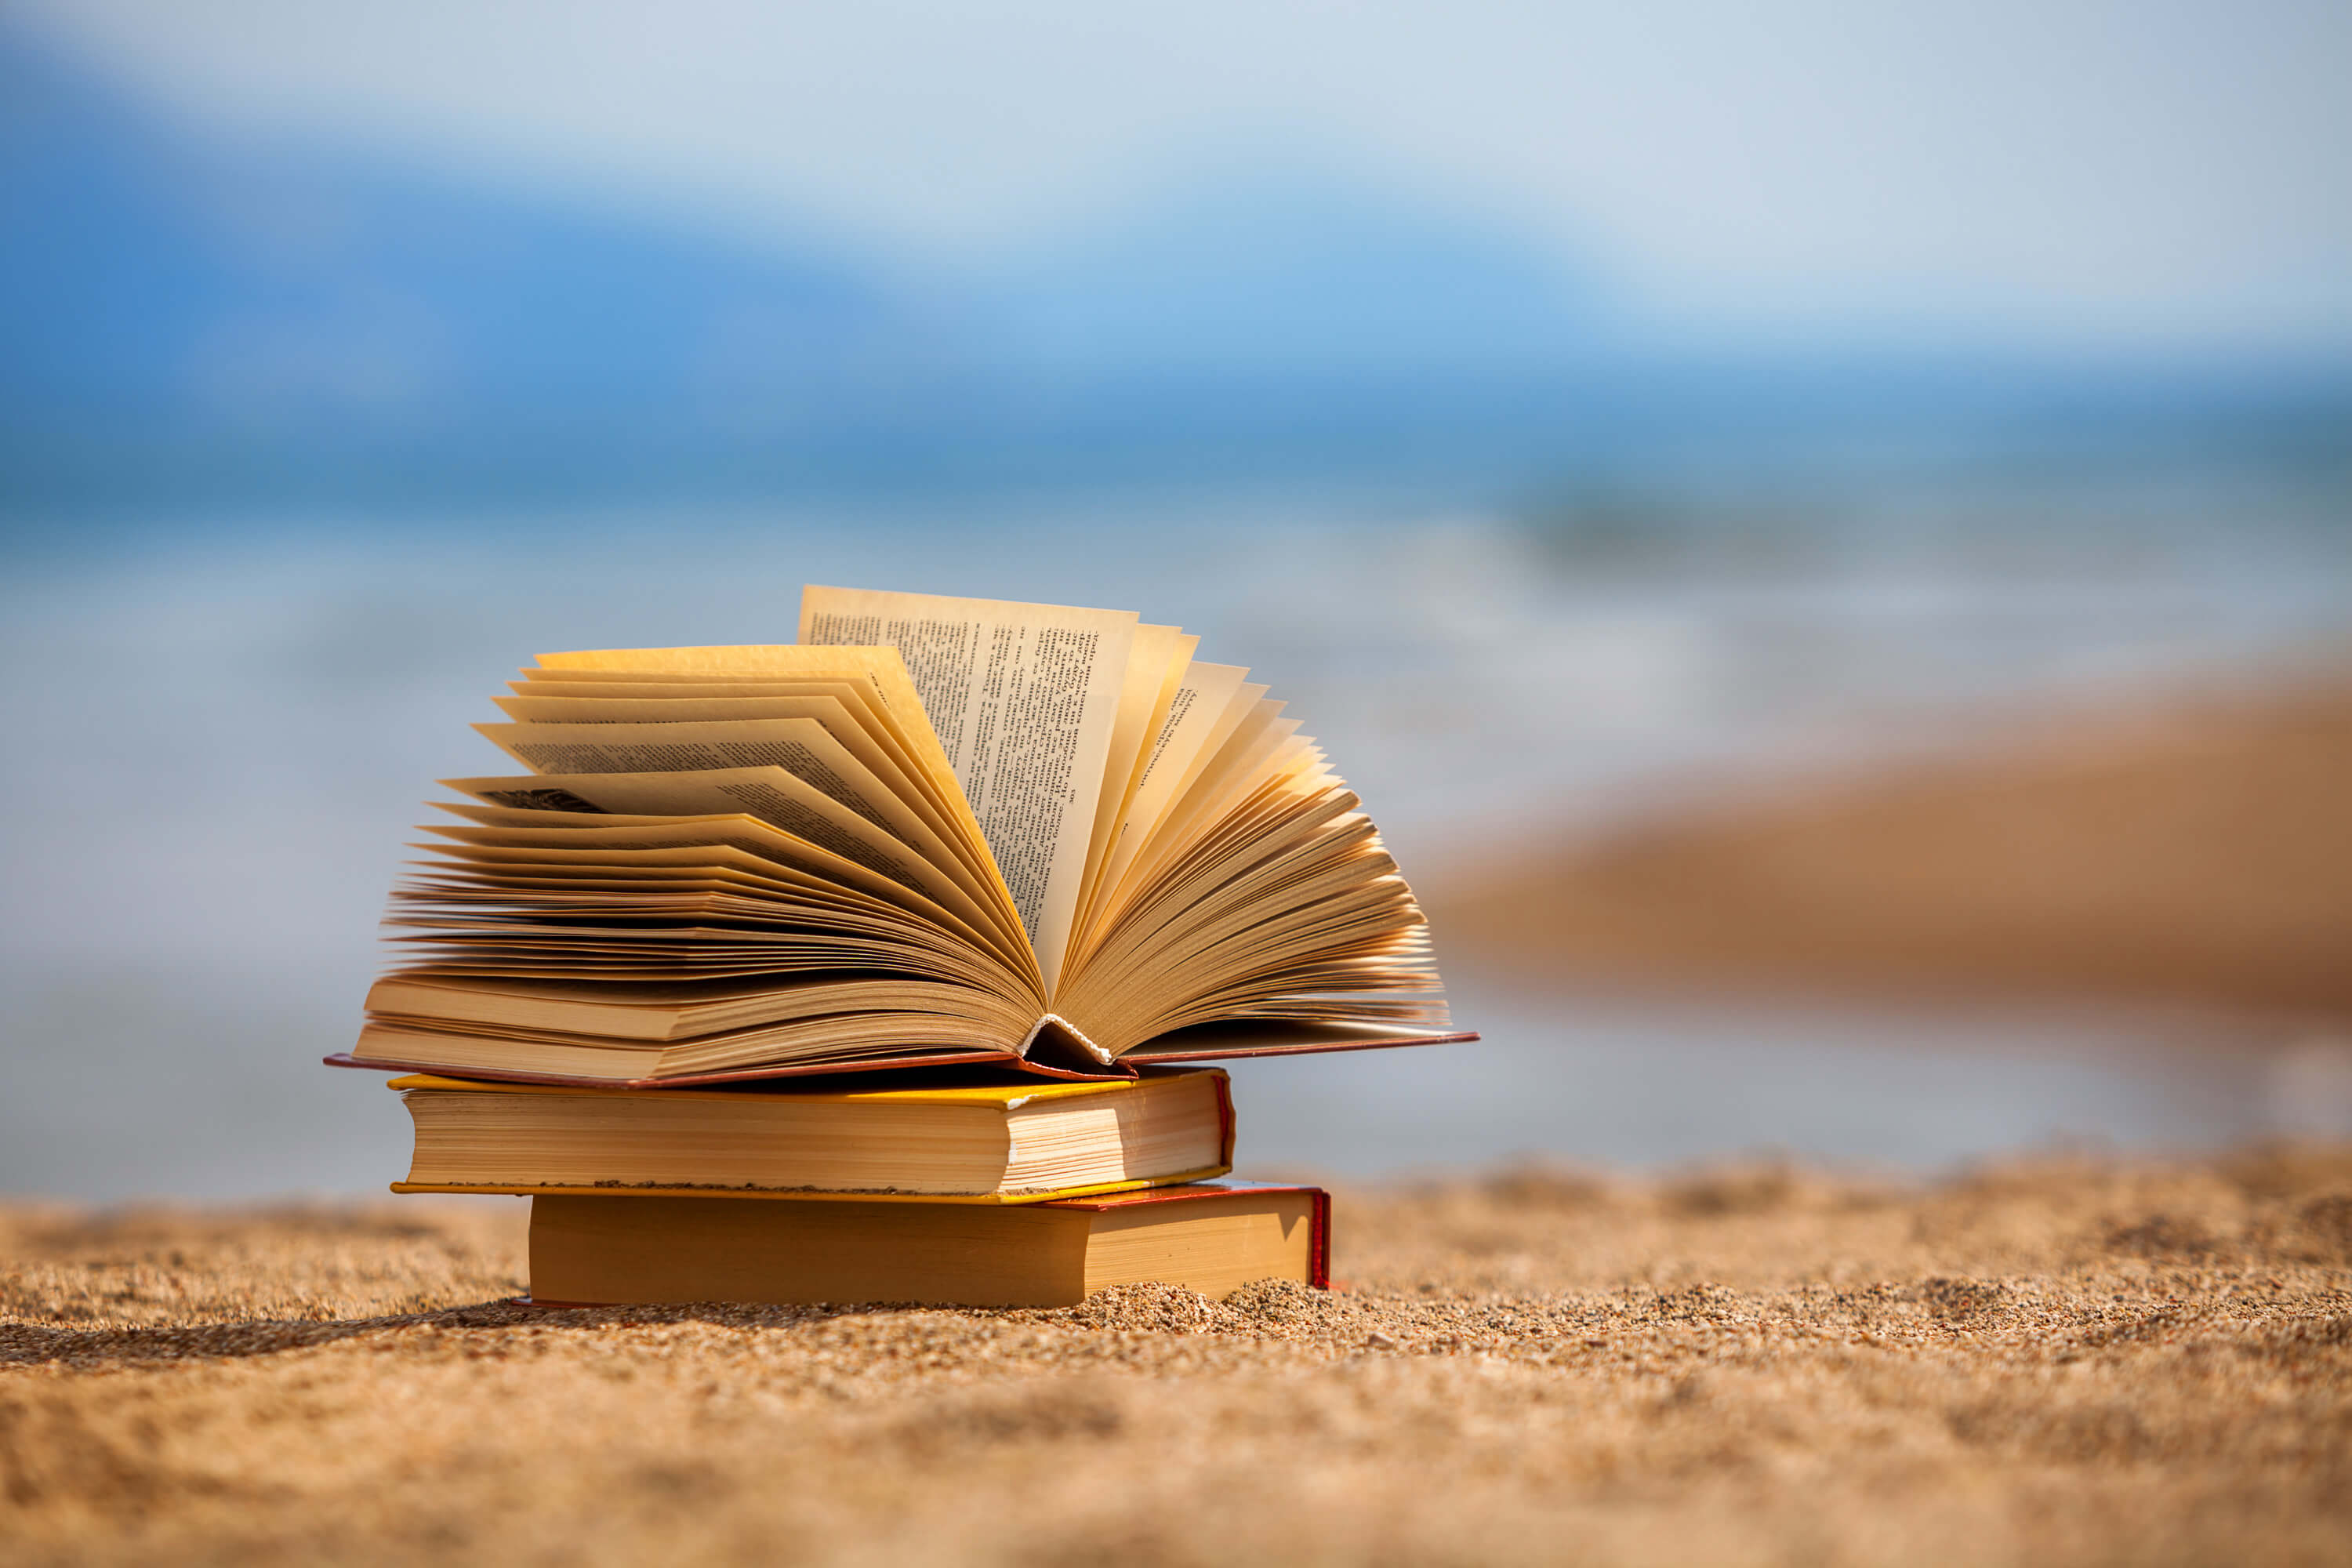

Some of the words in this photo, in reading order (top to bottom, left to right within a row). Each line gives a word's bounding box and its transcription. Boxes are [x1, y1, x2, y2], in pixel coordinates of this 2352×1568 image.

[943, 677, 953, 710] чтобы
[952, 719, 964, 768] которым
[967, 622, 981, 676] шептался
[957, 622, 968, 664] гораздо
[970, 760, 976, 773] не
[973, 699, 986, 757] сравнится.
[982, 654, 994, 695] Только
[990, 736, 1006, 799] проклятие,
[1003, 694, 1013, 731] оттого
[1019, 626, 1025, 639] не
[1022, 681, 1035, 728] причине
[1033, 662, 1038, 675] ее
[1035, 627, 1045, 656] бере-
[1174, 689, 1199, 726] минуту.
[950, 726, 956, 740] по
[954, 691, 963, 723] своей
[970, 765, 982, 811] ставили
[978, 713, 991, 761] вовремя,
[989, 670, 998, 699] даже
[995, 624, 1006, 666] просле-
[975, 776, 985, 811] самом
[982, 746, 991, 772] деле
[988, 703, 998, 741] хотите
[996, 665, 1005, 699] иметь
[1003, 625, 1013, 661] опеку-
[989, 816, 998, 843] руку
[996, 751, 1009, 803] положил
[1006, 735, 1012, 747] на
[1009, 703, 1018, 731] свою
[1014, 664, 1025, 700] шпагу.
[998, 816, 1004, 829] со
[1011, 718, 1022, 753] сказал
[1008, 804, 1019, 841] сидеть
[1018, 749, 1030, 790] кресле,
[1031, 704, 1037, 721] же
[1034, 677, 1043, 701] стал
[1040, 627, 1052, 673] слушать
[1010, 755, 1022, 800] подругу
[1013, 834, 1020, 849] он
[1017, 779, 1030, 829] различал
[1027, 739, 1037, 775] голоса
[1034, 685, 1047, 735] третьего
[1044, 628, 1059, 682] сословия;
[1018, 735, 1025, 749] по
[1019, 873, 1031, 900] Если
[1028, 844, 1036, 868] враг
[1034, 796, 1047, 840] нападет
[1044, 758, 1054, 793] снова,
[1054, 696, 1066, 731] равно,
[1062, 667, 1071, 692] будь
[1068, 649, 1074, 663] то
[1021, 827, 1027, 841] но
[1025, 765, 1040, 822] насмешки
[1039, 672, 1057, 747] строптивости
[1058, 628, 1065, 642] не
[1024, 813, 1036, 858] наречие
[1034, 793, 1040, 807] не
[1038, 728, 1052, 786] помешало
[1050, 702, 1058, 723] ему
[1055, 652, 1068, 695] уловить
[1024, 878, 1036, 916] немцы
[1039, 818, 1049, 848] даже
[1046, 754, 1062, 814] англичане,
[1063, 694, 1073, 725] люди
[1069, 658, 1080, 689] будут
[1040, 867, 1051, 899] война
[1047, 842, 1056, 862] тем
[1052, 803, 1065, 839] более.
[1060, 782, 1069, 798] Но
[1065, 765, 1072, 778] на
[1069, 728, 1080, 761] худой
[1076, 690, 1087, 724] конец
[1088, 630, 1099, 661] пред-
[1004, 805, 1012, 833] свою
[1027, 884, 1041, 930] сторону
[1038, 844, 1049, 881] своего
[1046, 798, 1059, 841] короля.
[1054, 775, 1063, 794] Им
[1060, 729, 1073, 771] вообще
[1069, 710, 1076, 725] ни
[1075, 669, 1085, 695] чему
